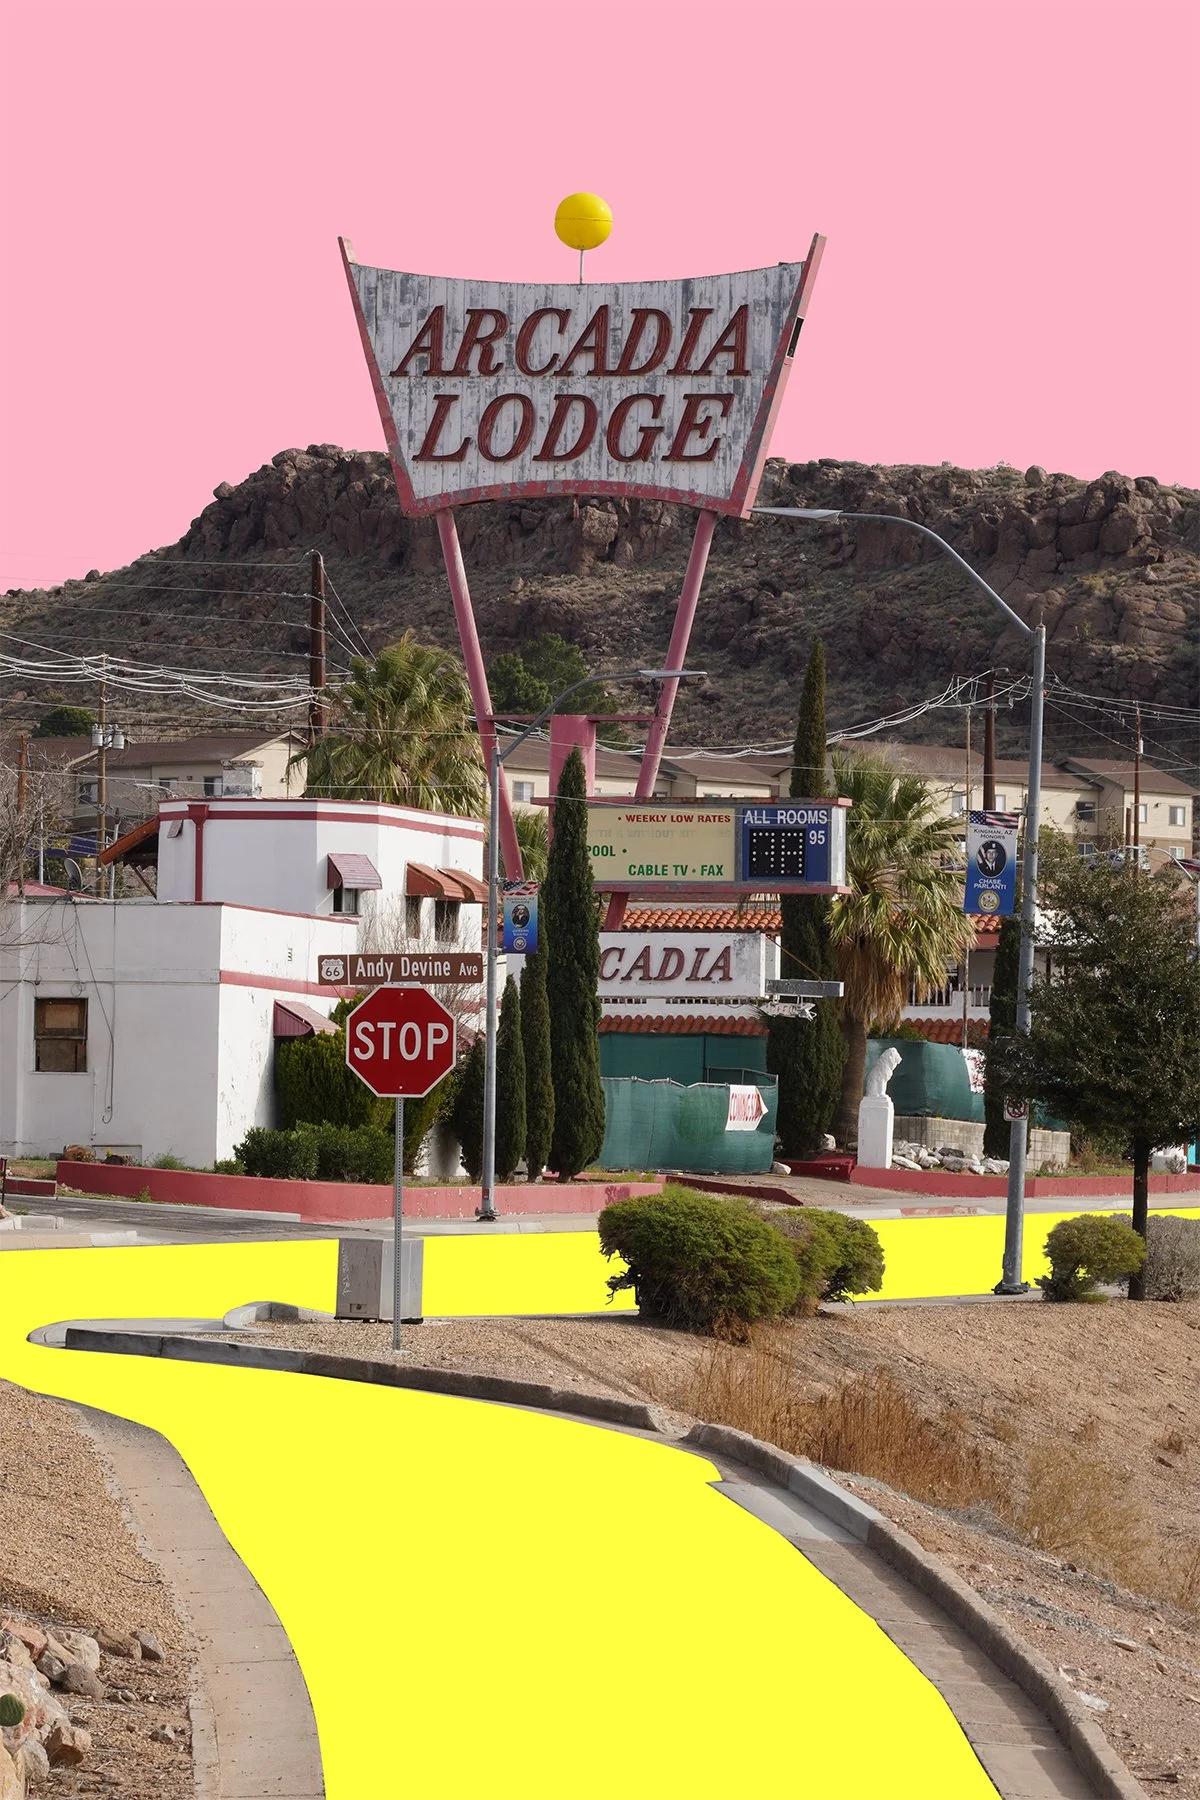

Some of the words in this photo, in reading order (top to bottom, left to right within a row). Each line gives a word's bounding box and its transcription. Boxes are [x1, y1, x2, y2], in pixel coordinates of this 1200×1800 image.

[390, 304, 751, 377] ARCADIA
[412, 393, 735, 463] LODGE
[625, 814, 667, 823] WEEKLY
[671, 814, 694, 823] LOW
[697, 814, 731, 823] RATES
[744, 810, 770, 824] ALL
[777, 810, 828, 824] ROOMS
[809, 830, 826, 845] 95
[628, 865, 668, 876] CABLE
[673, 865, 688, 876] TV
[700, 865, 723, 876] FAX
[325, 966, 340, 977] 66
[355, 957, 394, 981] Andy
[401, 956, 451, 977] Devine
[459, 963, 478, 976] Ave
[354, 1021, 449, 1061] STOP
